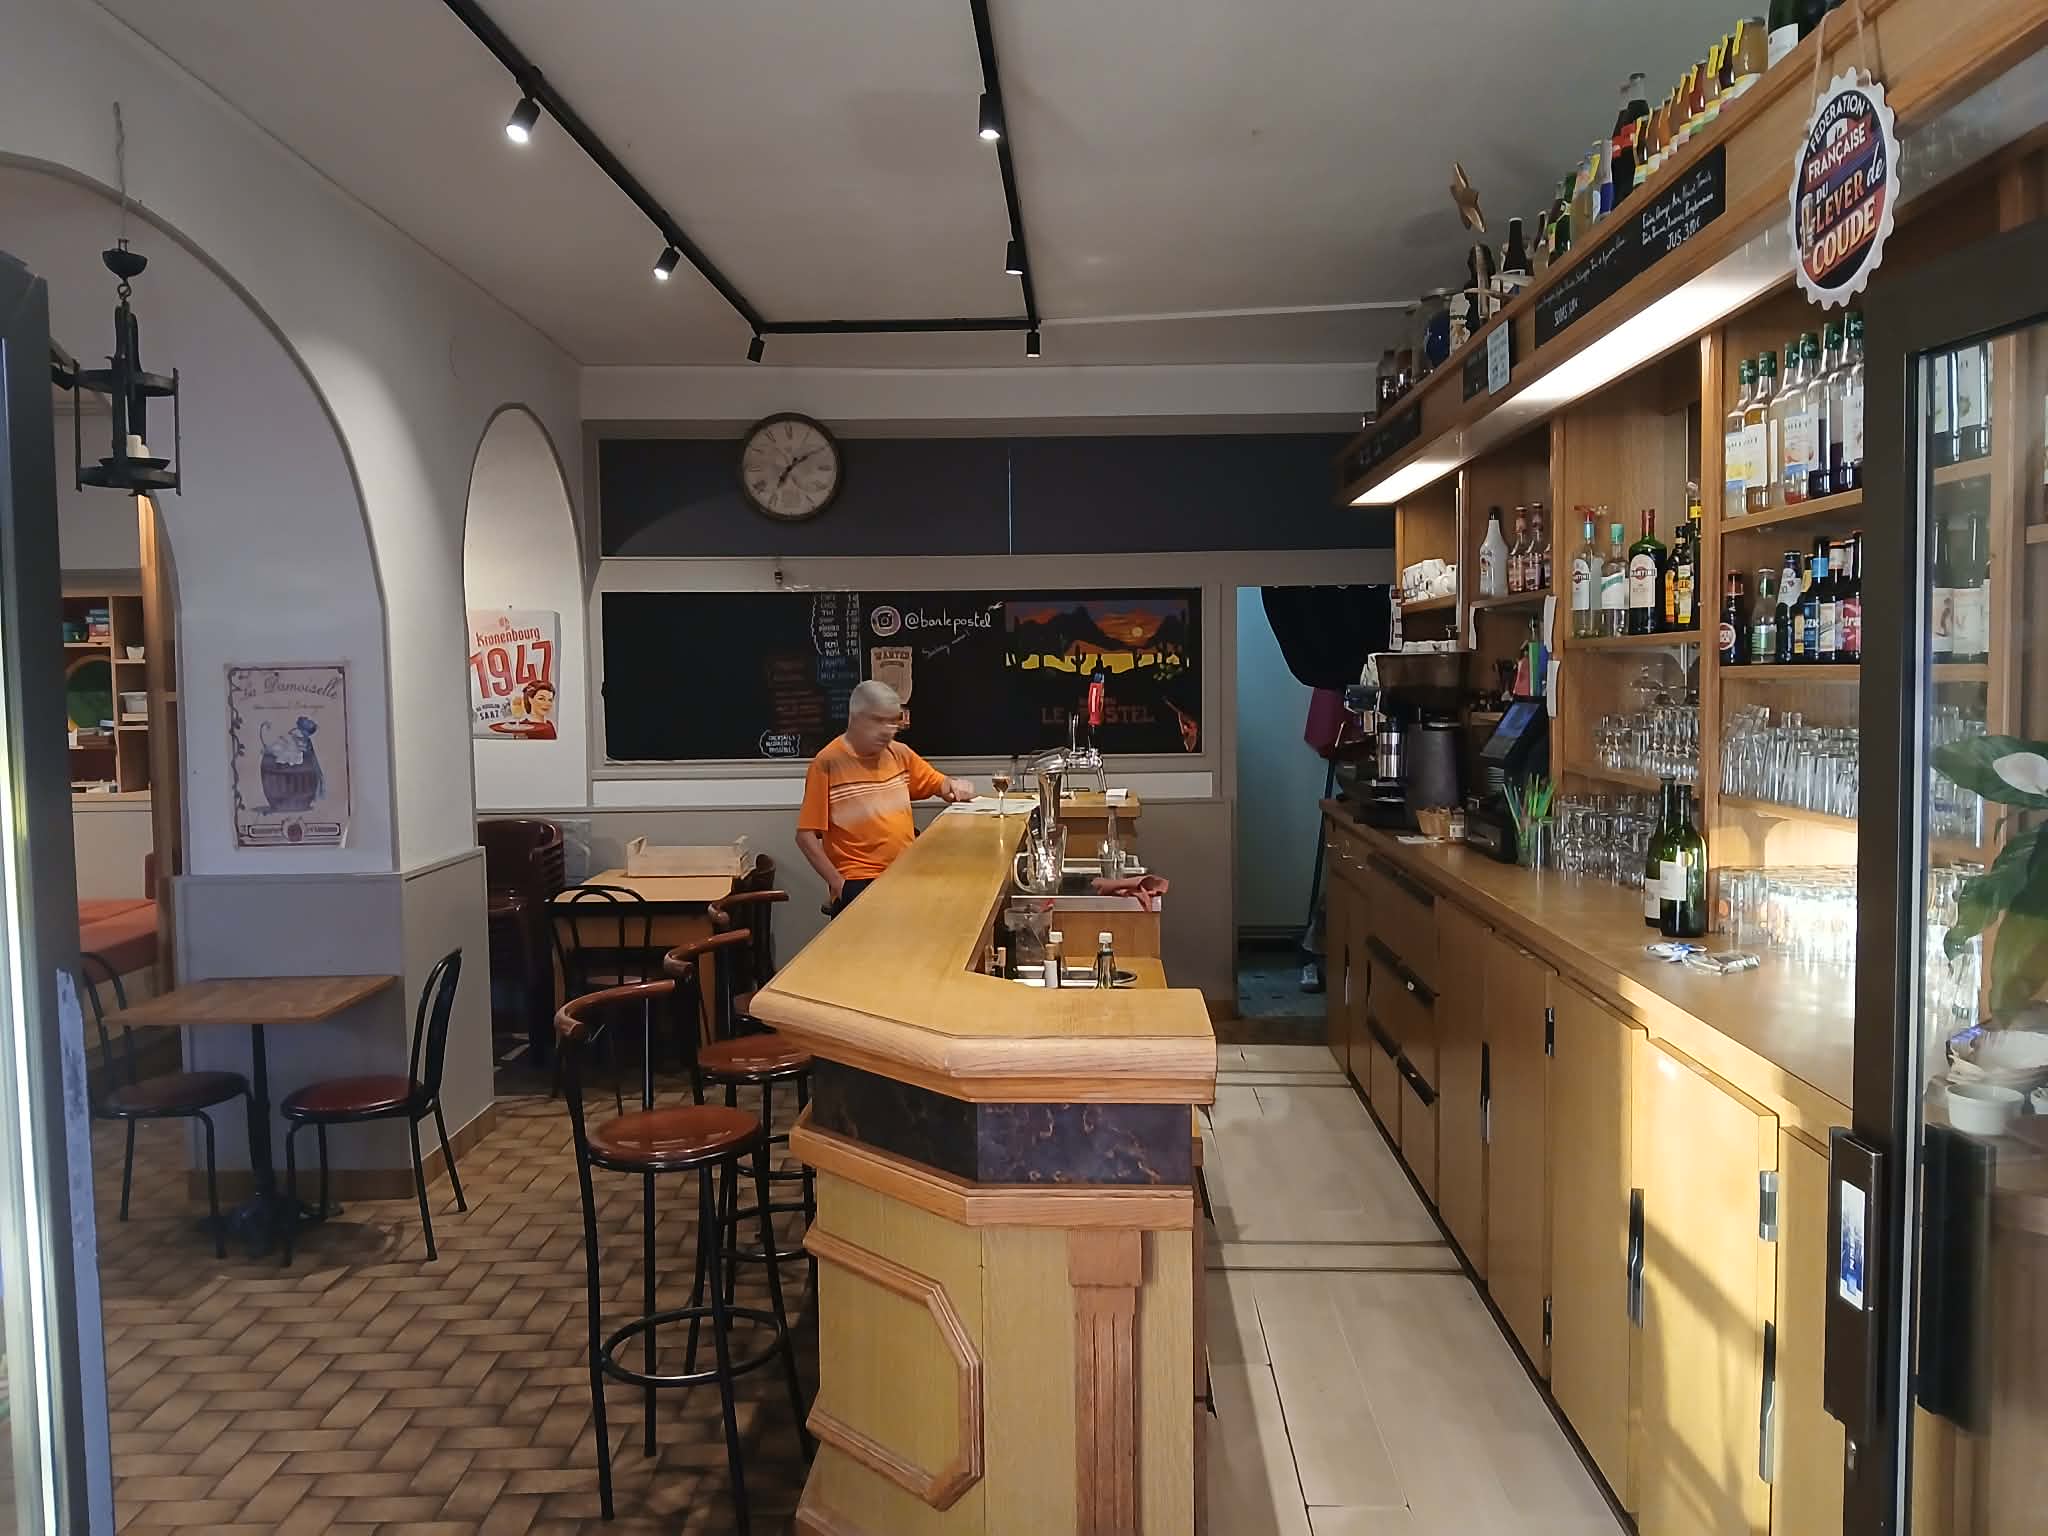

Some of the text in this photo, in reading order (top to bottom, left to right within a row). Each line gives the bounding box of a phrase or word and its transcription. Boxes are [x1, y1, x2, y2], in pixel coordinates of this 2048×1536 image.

[1810, 94, 1866, 151] FEDERATION
[1808, 122, 1866, 183] FRANÇAISE
[1815, 181, 1829, 205] DU
[1816, 143, 1884, 233] LEVER de
[1666, 229, 1682, 251] JUS
[1812, 194, 1876, 275] COUDE
[475, 627, 541, 647] Kronenbourg
[469, 639, 554, 699] 1947
